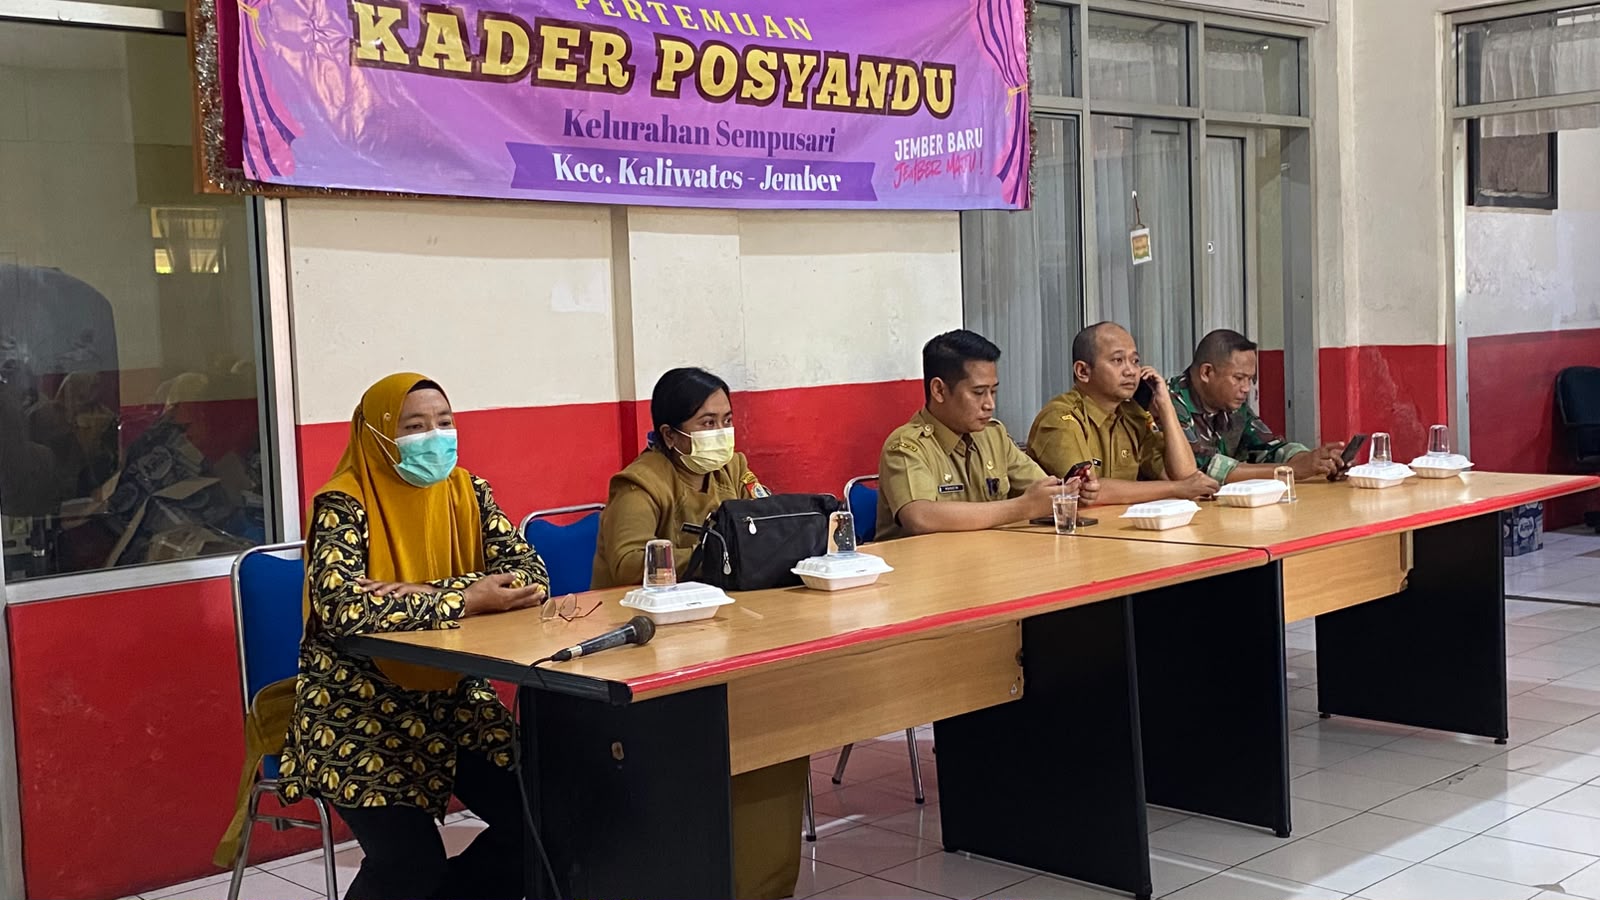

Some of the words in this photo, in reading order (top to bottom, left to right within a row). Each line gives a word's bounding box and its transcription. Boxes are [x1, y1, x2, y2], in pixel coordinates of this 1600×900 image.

[353, 1, 631, 89] KADER
[655, 38, 954, 115] POSYANDU
[563, 108, 710, 146] Kelurahan
[716, 119, 837, 158] Sempusari
[894, 133, 943, 162] JEMBER
[947, 127, 983, 153] BARU
[552, 152, 612, 184] Kec.
[618, 156, 744, 189] Kaliwates
[759, 164, 842, 192] Jember
[893, 159, 942, 190] JEMBER
